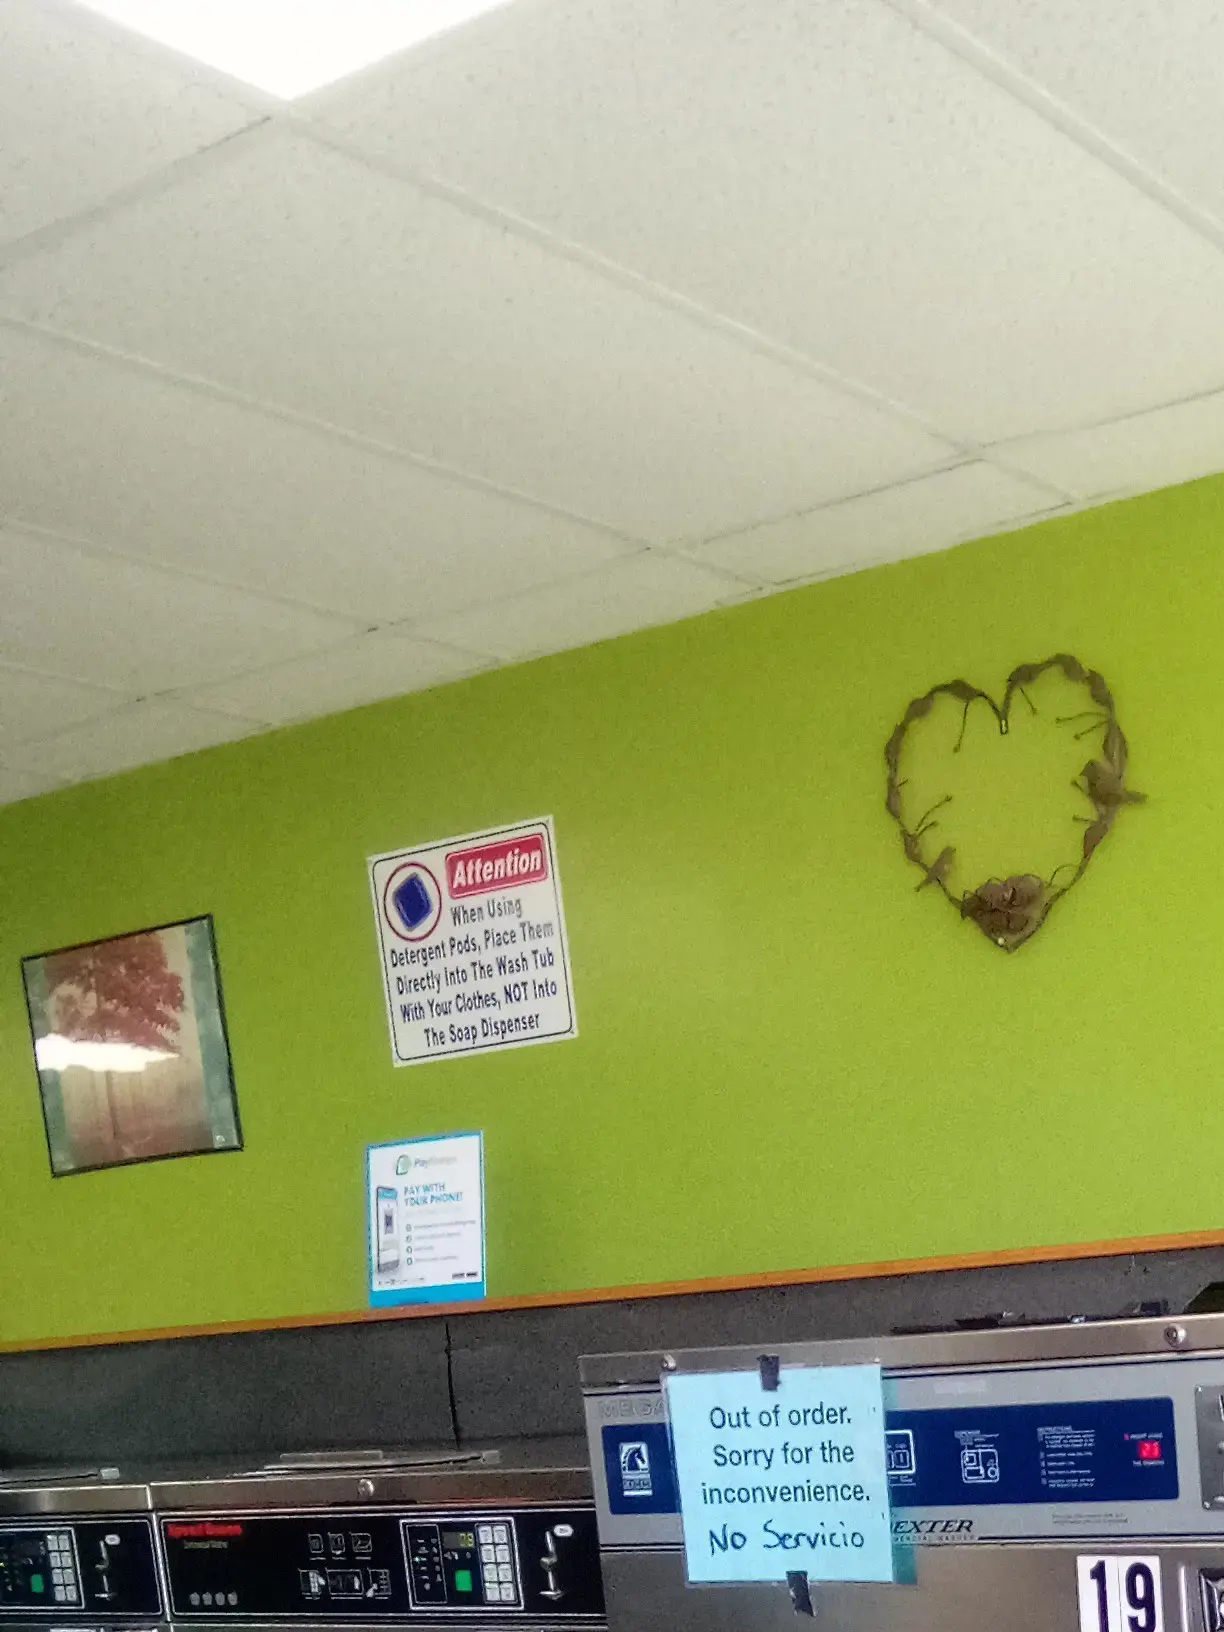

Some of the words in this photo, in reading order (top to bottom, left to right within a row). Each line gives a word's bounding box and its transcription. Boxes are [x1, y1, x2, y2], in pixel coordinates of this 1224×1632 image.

[452, 848, 542, 889] Attention
[451, 905, 484, 927] When
[487, 898, 522, 918] Using
[390, 942, 446, 969] Detergent
[449, 936, 481, 957] Pods,
[484, 928, 517, 947] Place
[520, 921, 554, 942] Them
[396, 969, 442, 995] Directly
[470, 960, 493, 980] The
[496, 954, 528, 976] Wash
[532, 947, 554, 969] Tub
[400, 1003, 425, 1023] With
[428, 998, 452, 1020] Your
[455, 990, 501, 1013] Clothes,
[504, 982, 528, 1004] NOT
[533, 979, 557, 999] Into
[424, 1026, 446, 1047] The
[449, 1022, 478, 1044] Soap
[481, 1013, 540, 1040] Dispenser
[709, 1405, 752, 1429] Out
[758, 1404, 782, 1427] of
[788, 1401, 852, 1426] order.
[713, 1444, 774, 1470] Sorry
[781, 1441, 813, 1465] for
[820, 1440, 854, 1463] the
[702, 1479, 870, 1505] inconvenience.
[709, 1523, 747, 1556] No
[763, 1518, 865, 1550] Servicio
[893, 1519, 973, 1533] EXTER
